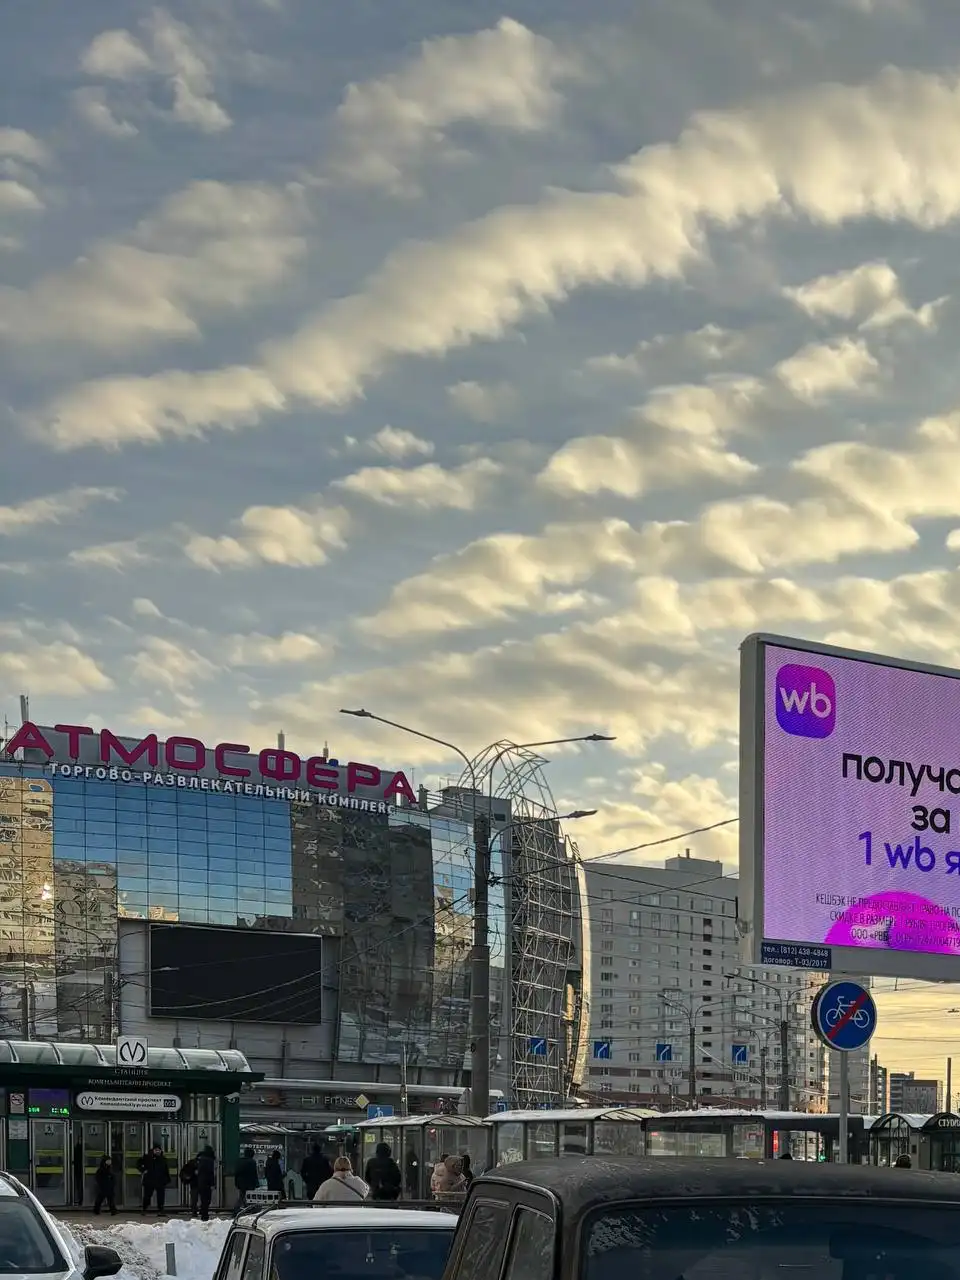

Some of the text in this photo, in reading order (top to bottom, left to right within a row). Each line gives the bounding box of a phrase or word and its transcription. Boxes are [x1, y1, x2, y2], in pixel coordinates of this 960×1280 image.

[779, 682, 832, 718] wb
[6, 720, 420, 805] АТМОСФЕРА
[49, 762, 397, 815] ТОРГОВО-РАЗВЛЕКАТЕЛЬНЫЙ КОМПЛЕКС
[910, 805, 951, 834] за
[858, 831, 873, 865] 1
[884, 836, 936, 872] wb
[816, 893, 846, 907] КЕШБЭК
[830, 910, 859, 924] СКИДКЕ
[866, 914, 897, 926] РАЗМЕРЕ
[851, 928, 869, 939] ООО
[780, 945, 798, 955] (812)
